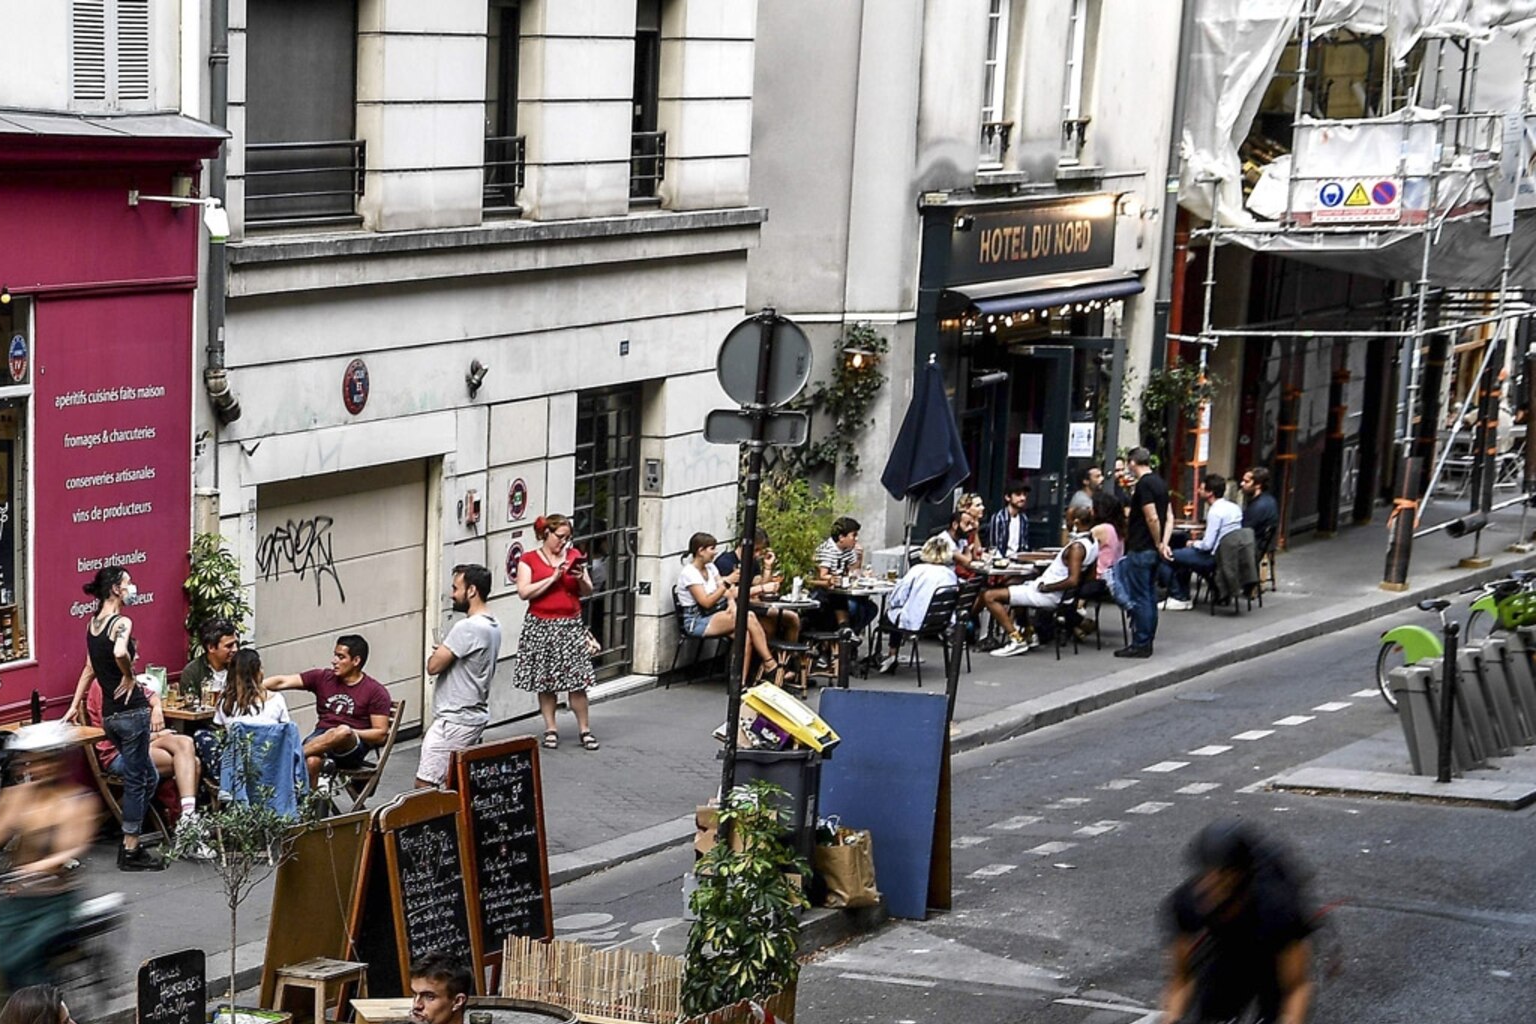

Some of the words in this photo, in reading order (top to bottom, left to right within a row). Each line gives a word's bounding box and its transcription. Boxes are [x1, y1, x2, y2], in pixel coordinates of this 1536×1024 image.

[979, 226, 1028, 263] HOTEL
[1031, 224, 1052, 258] DU
[1053, 219, 1092, 255] NORD
[55, 389, 87, 410] apéritifs
[88, 387, 119, 404] cuisinés
[120, 385, 136, 401] faits
[137, 384, 165, 399] maison
[64, 433, 101, 449] fromages
[101, 430, 109, 444] &
[110, 426, 156, 443] charcuteries
[66, 471, 114, 489] conserveries
[115, 466, 156, 484] artisanales
[72, 509, 90, 523] vins
[91, 506, 102, 521] de
[103, 502, 152, 522] producteurs
[103, 549, 146, 568] artisanales
